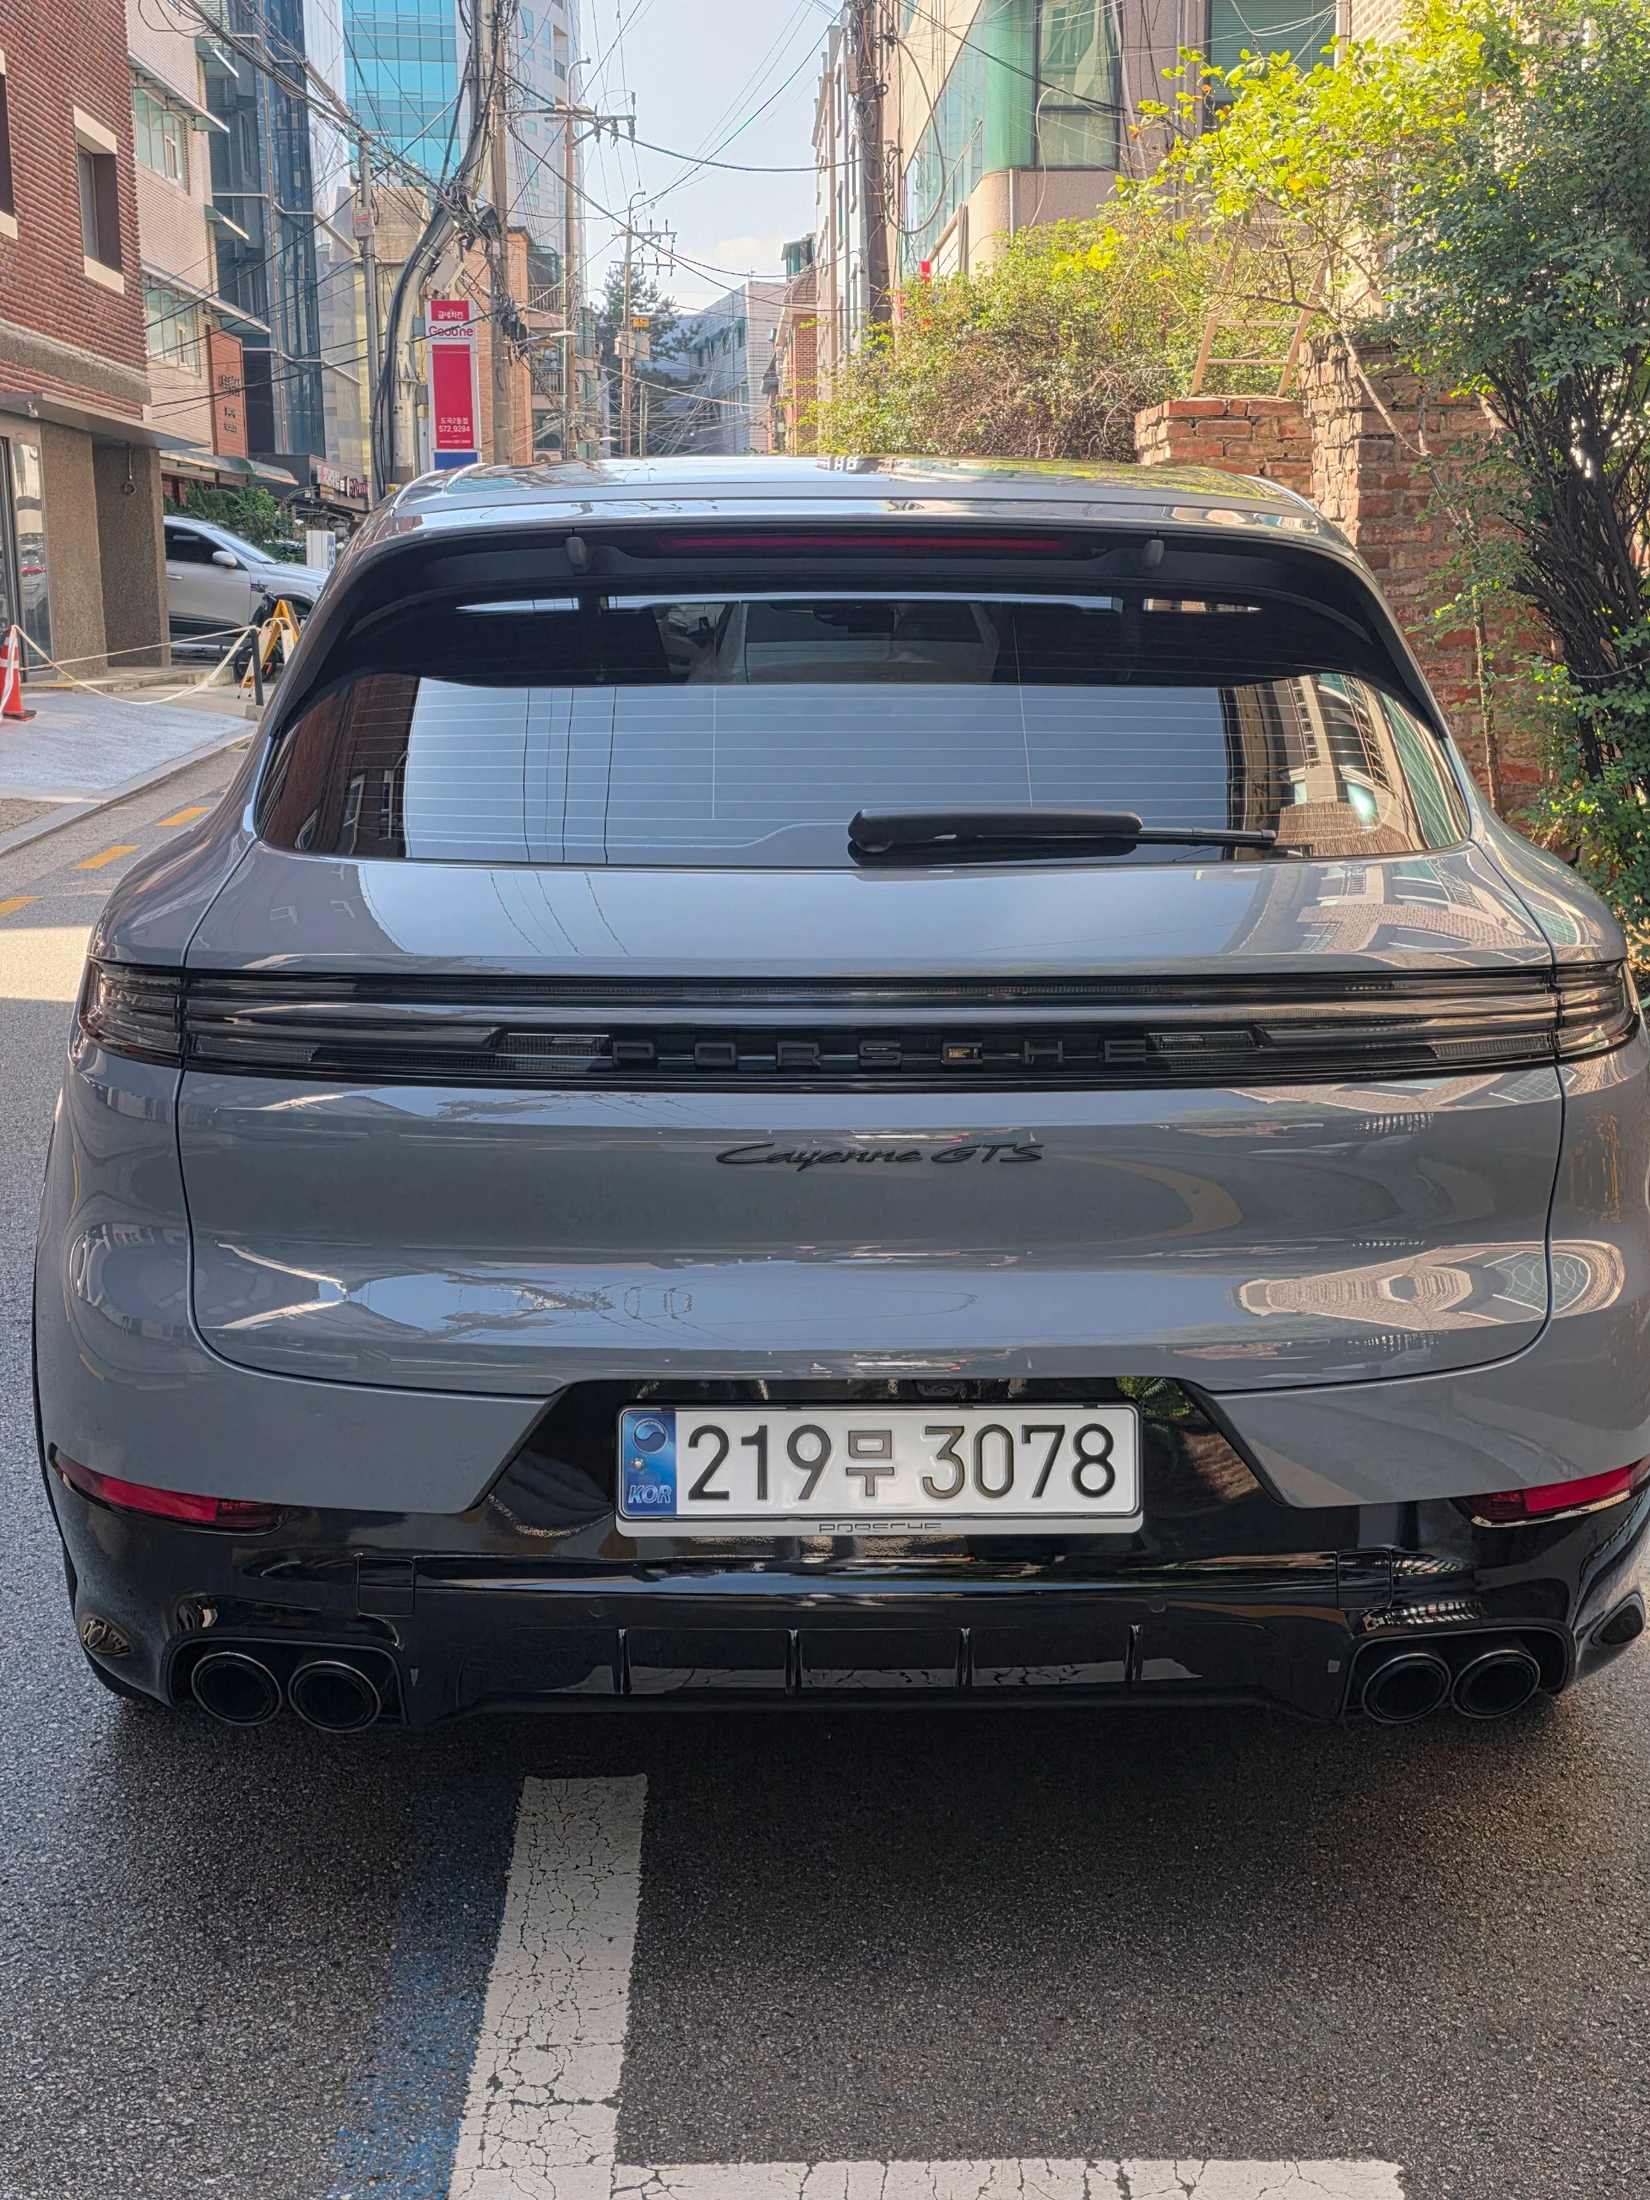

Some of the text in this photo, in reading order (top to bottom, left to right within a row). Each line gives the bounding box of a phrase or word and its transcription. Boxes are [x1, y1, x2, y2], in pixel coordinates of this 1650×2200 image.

[612, 1039, 1148, 1067] PORSCHE
[715, 1142, 1045, 1172] Cayenne GTS
[687, 1423, 1116, 1501] 219무 3078
[628, 1484, 672, 1504] KOR
